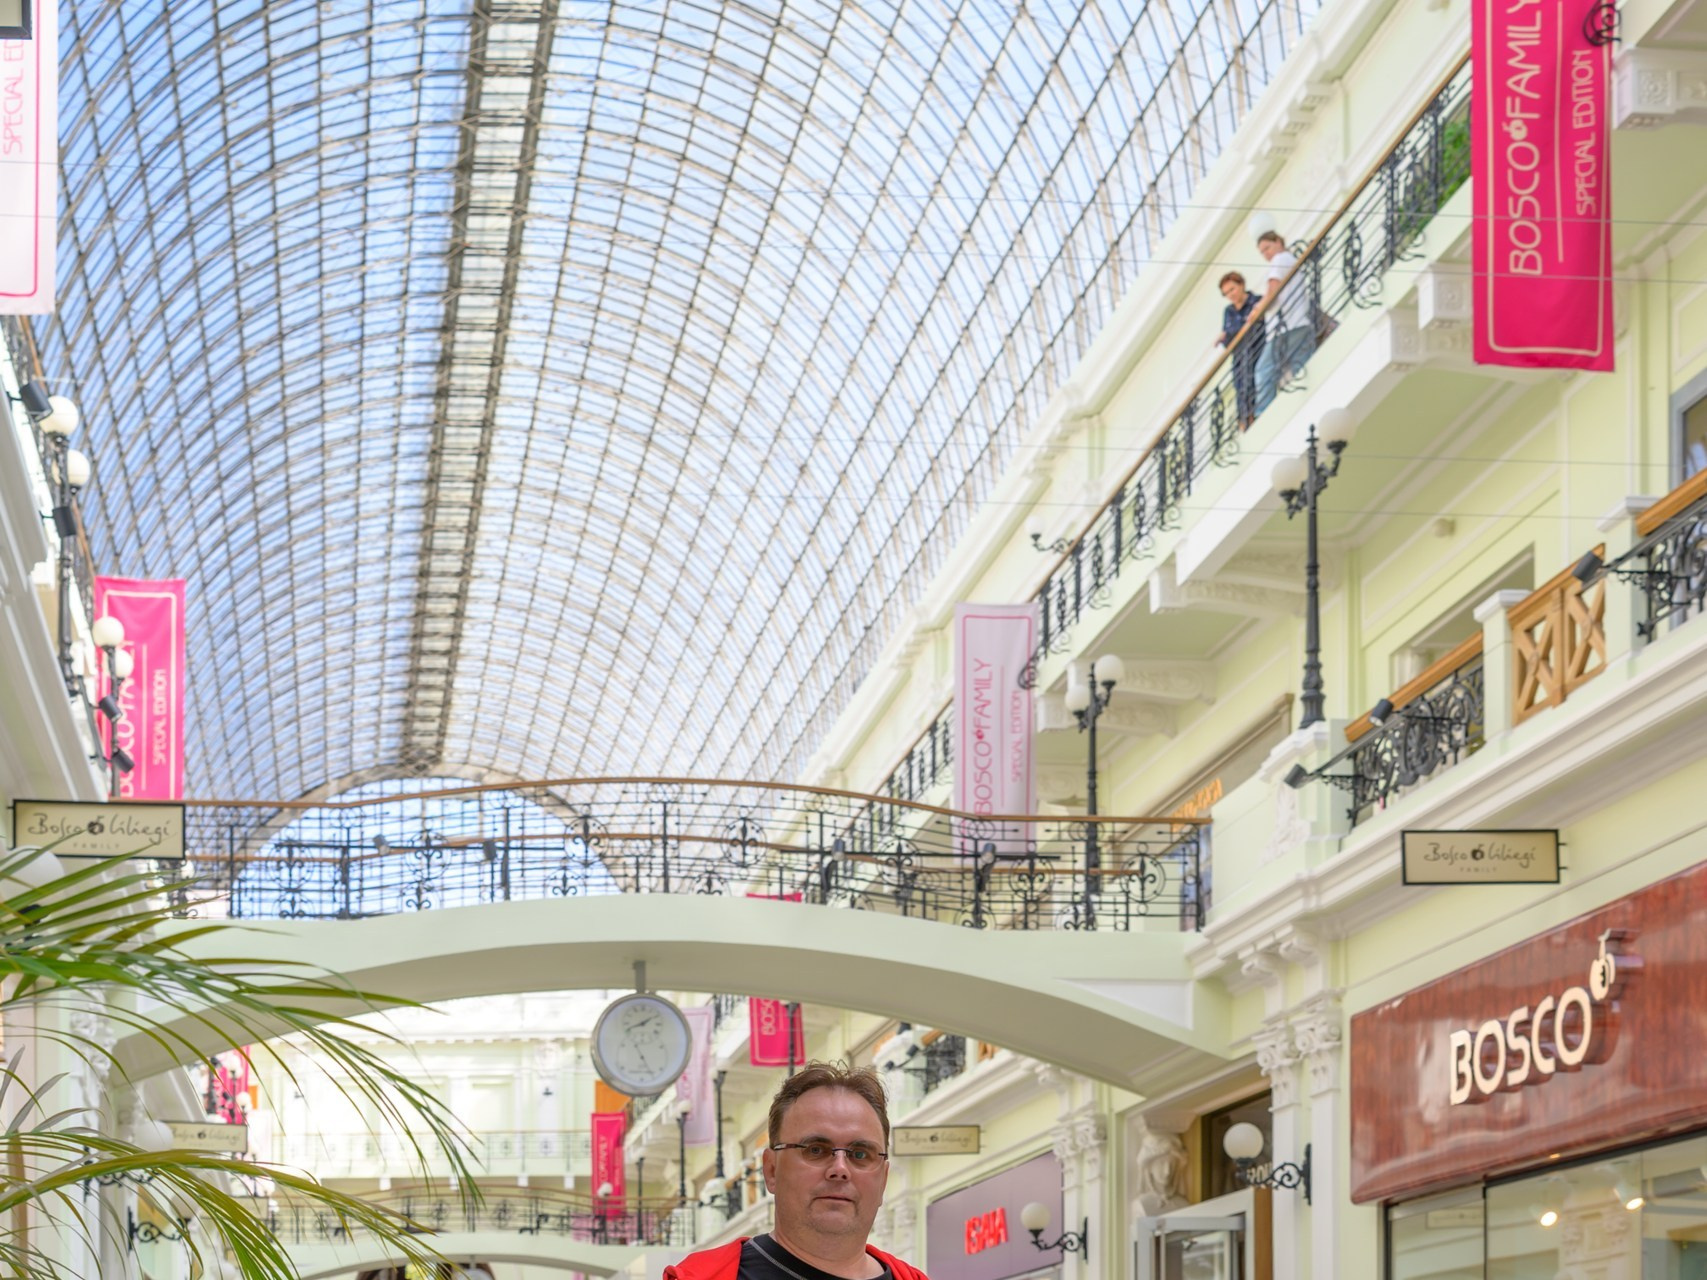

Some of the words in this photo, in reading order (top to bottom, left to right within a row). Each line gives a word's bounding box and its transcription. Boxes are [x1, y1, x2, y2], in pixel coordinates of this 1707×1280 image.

[3, 68, 24, 155] SPECIAL
[1571, 49, 1596, 129] EDITION
[1507, 141, 1542, 275] BOSCO
[1576, 132, 1596, 216] SPECIAL
[973, 658, 993, 730] FAMILY
[1011, 689, 1022, 734] EDITION
[973, 740, 993, 816] BOSCO
[1450, 987, 1591, 1105] BOSCO
